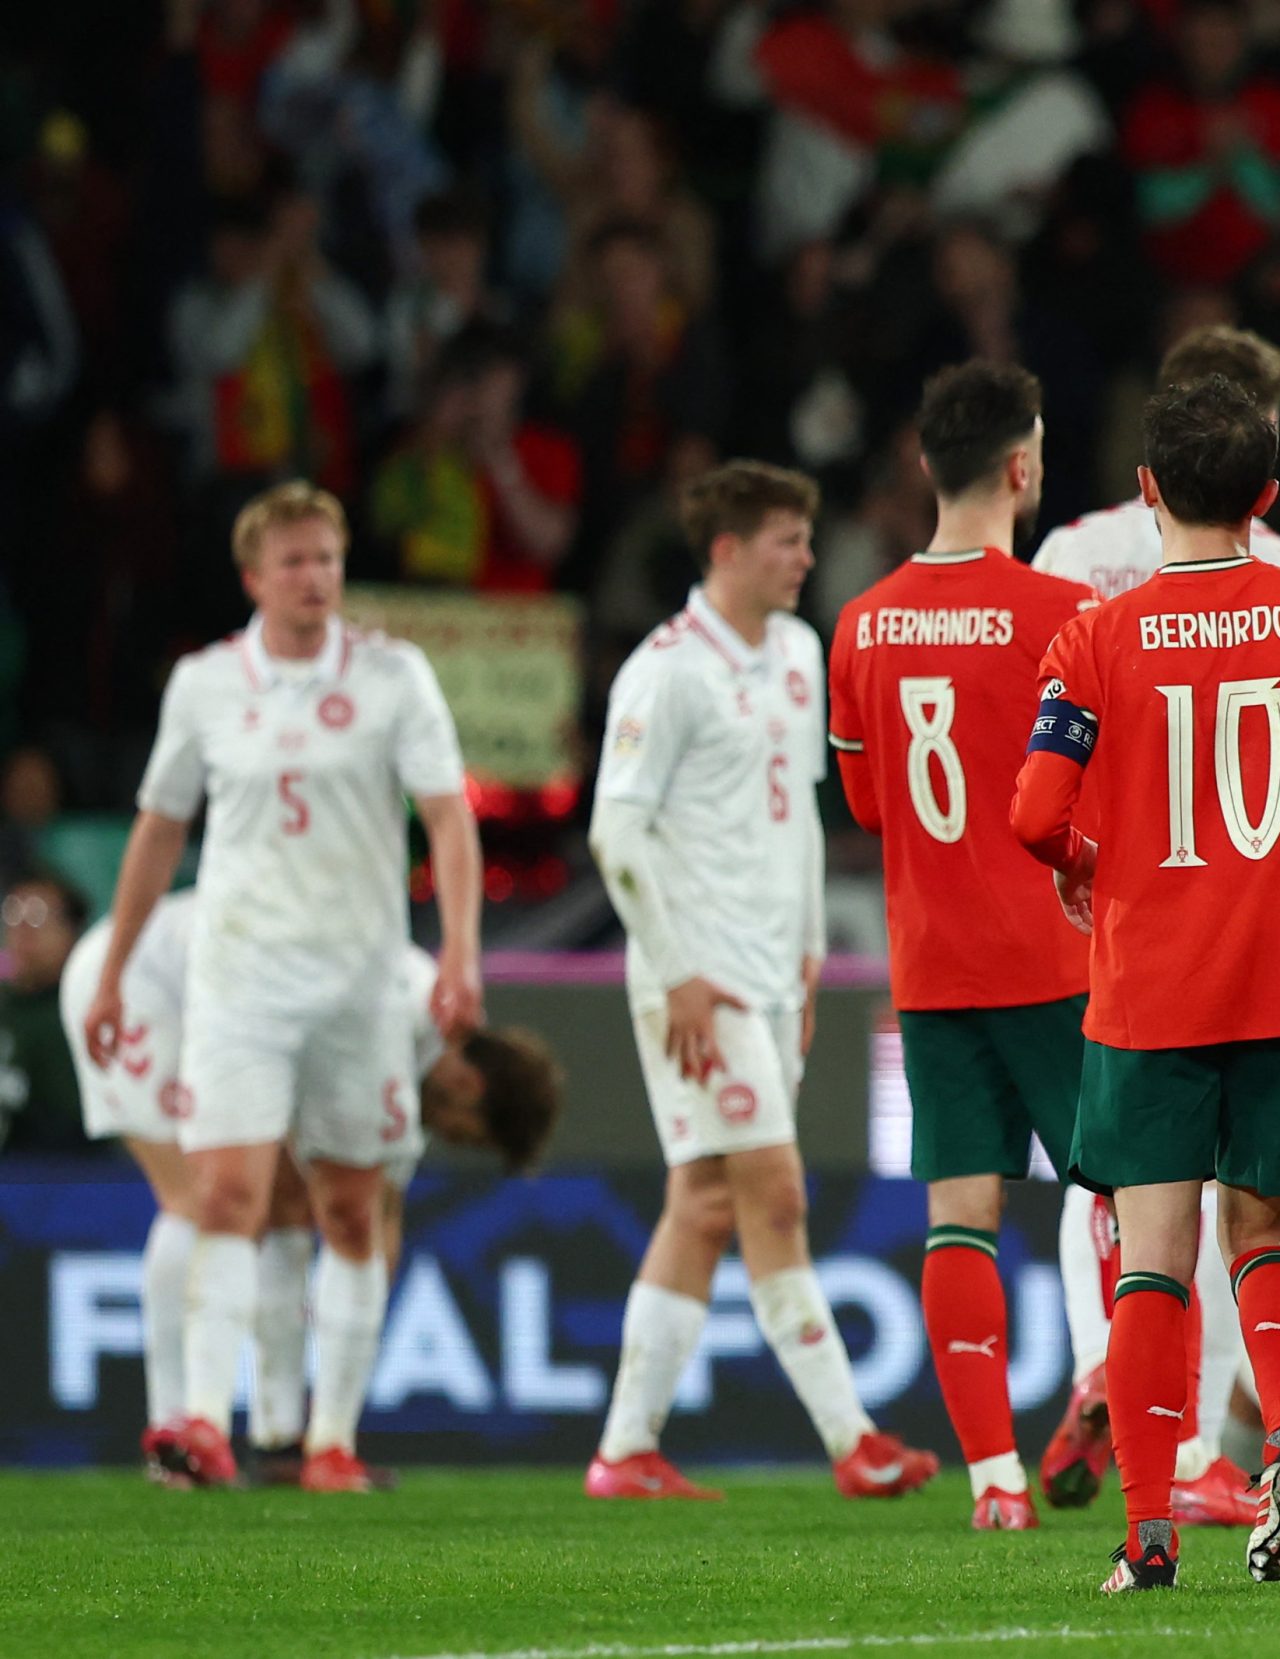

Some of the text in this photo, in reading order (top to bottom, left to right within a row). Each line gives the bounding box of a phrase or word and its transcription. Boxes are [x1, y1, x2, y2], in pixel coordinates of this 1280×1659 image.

[768, 754, 789, 823] 6
[899, 676, 967, 843] 8
[278, 770, 309, 837] 5
[380, 1078, 406, 1142] 5
[50, 1252, 606, 1411] FAL
